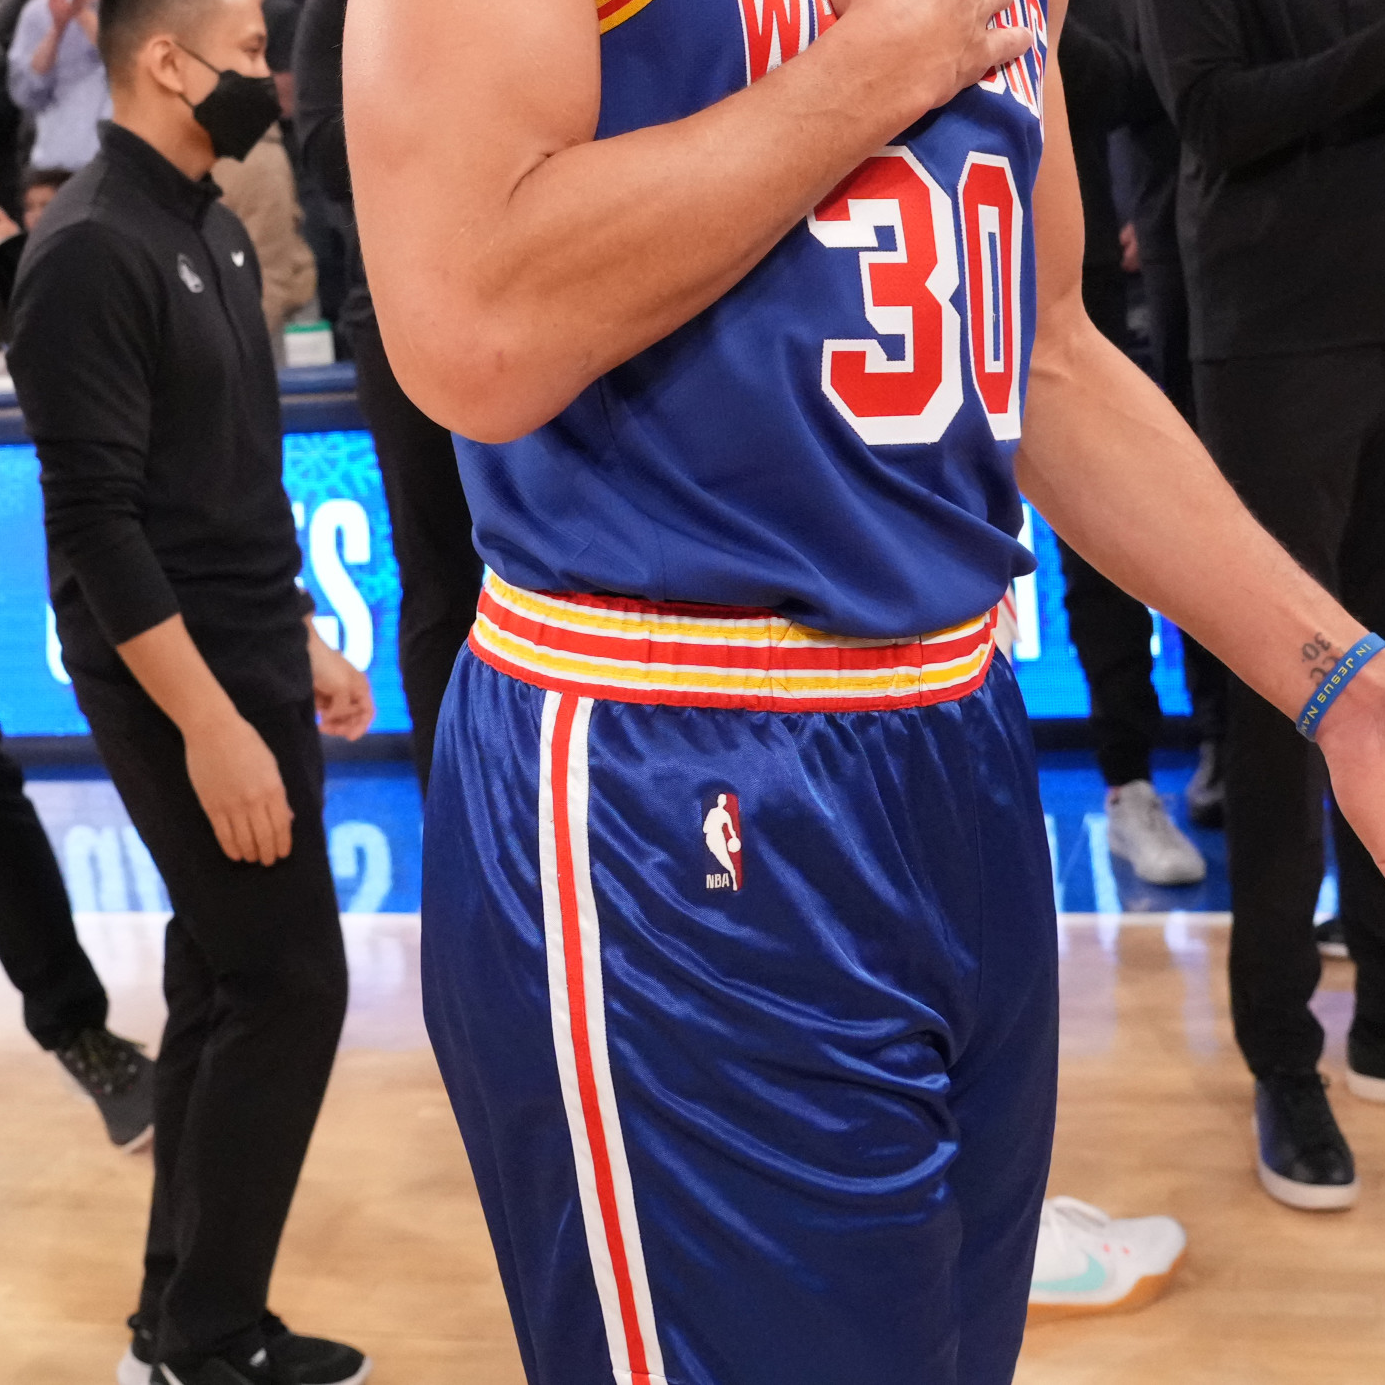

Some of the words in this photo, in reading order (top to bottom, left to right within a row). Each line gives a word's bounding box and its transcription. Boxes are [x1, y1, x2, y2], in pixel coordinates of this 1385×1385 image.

[806, 146, 1022, 445] 30
[1356, 643, 1372, 657] IN
[1316, 657, 1355, 704] JESUS
[705, 872, 731, 889] NBA
